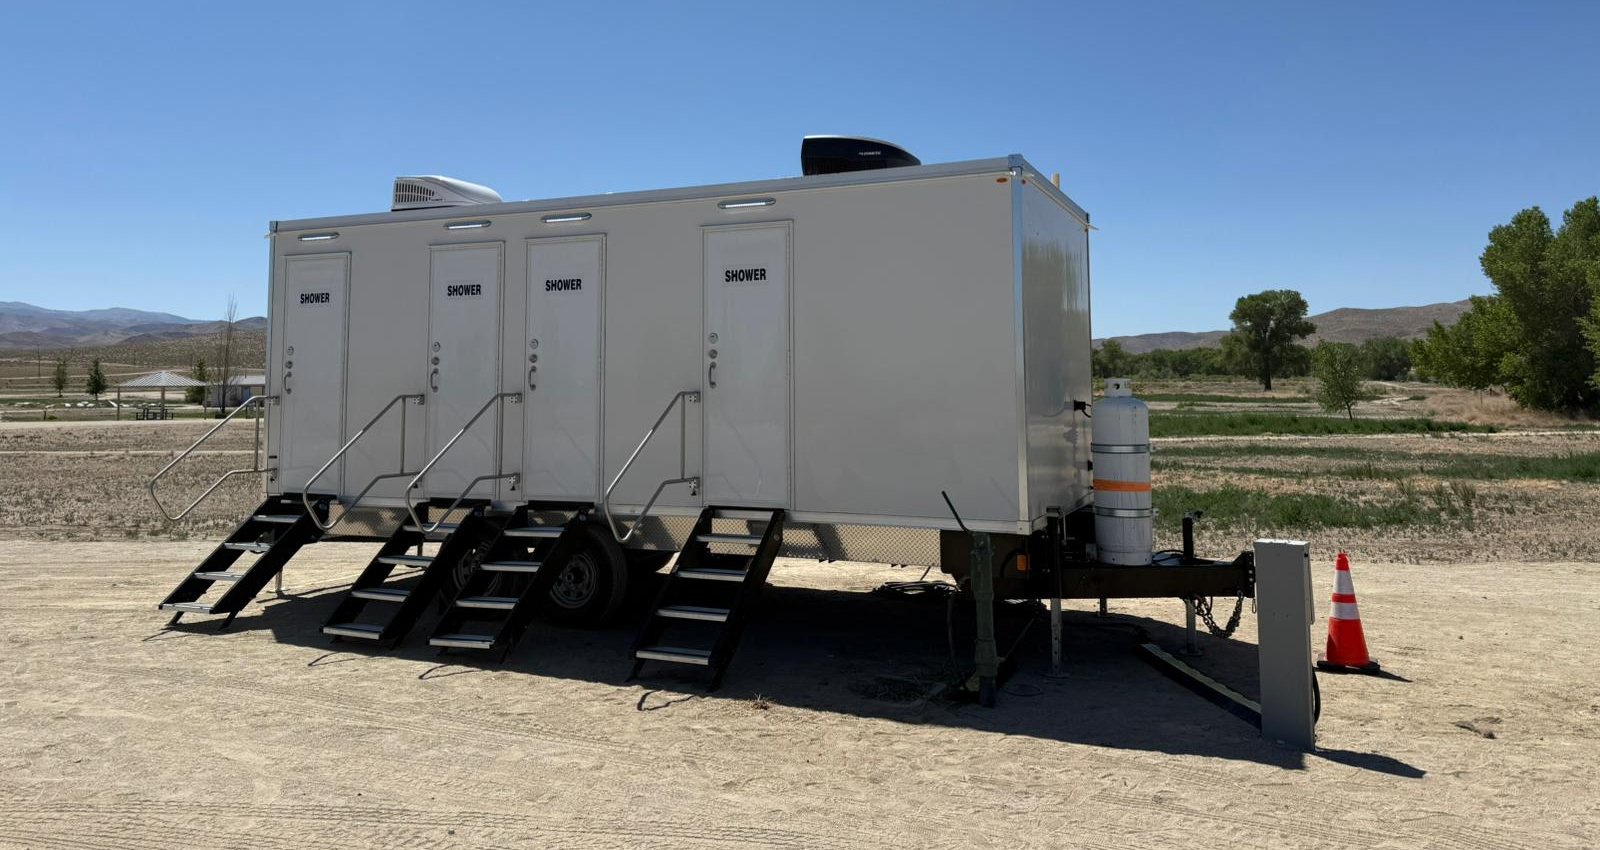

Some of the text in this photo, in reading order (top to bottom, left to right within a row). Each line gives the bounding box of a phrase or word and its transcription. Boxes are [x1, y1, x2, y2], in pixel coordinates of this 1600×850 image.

[725, 268, 766, 283] SHOWER
[447, 284, 482, 297] SHOWER
[545, 279, 582, 292] SHOWER
[300, 293, 330, 305] SHOWER
